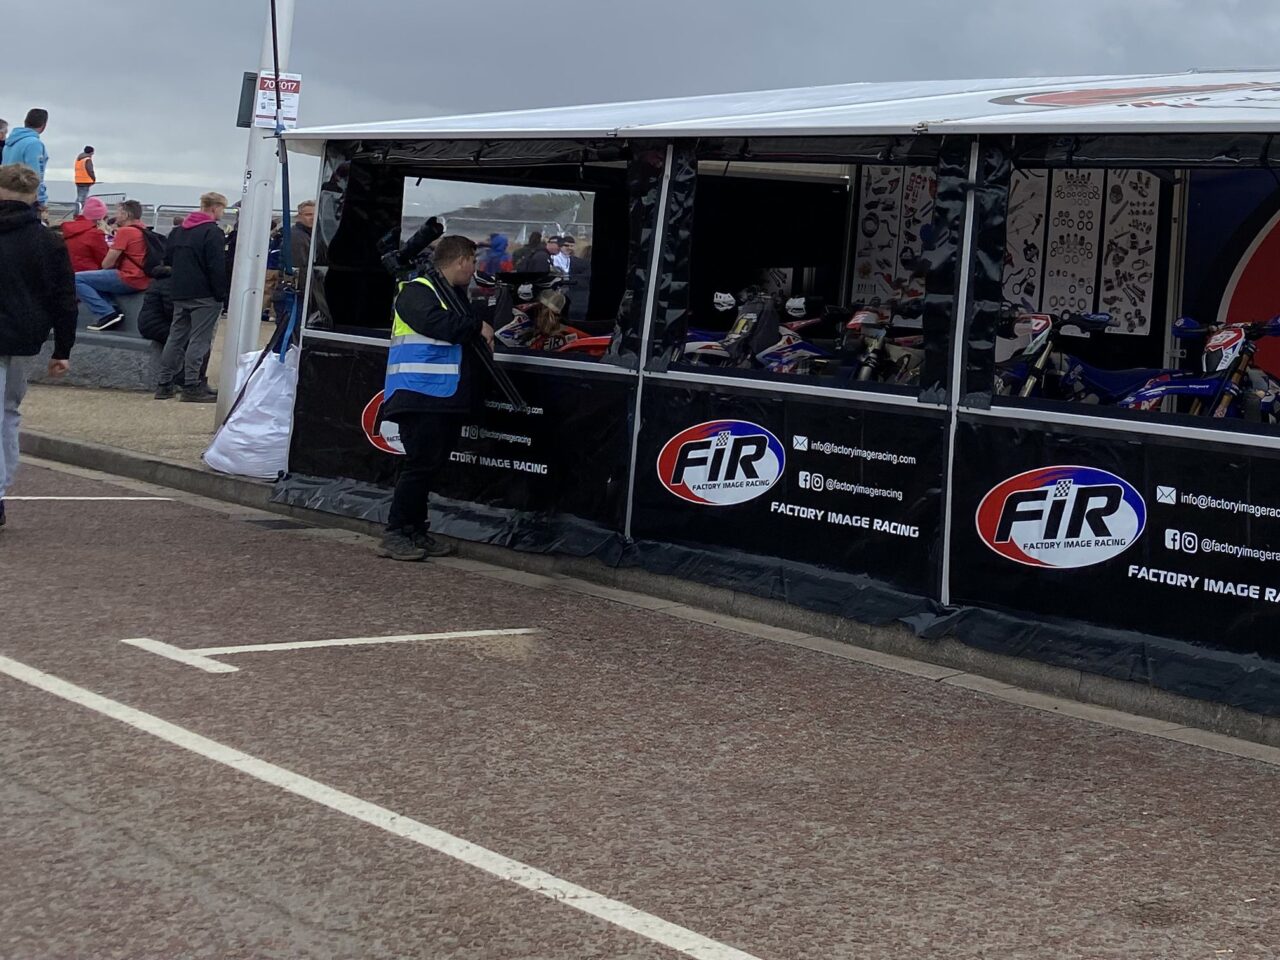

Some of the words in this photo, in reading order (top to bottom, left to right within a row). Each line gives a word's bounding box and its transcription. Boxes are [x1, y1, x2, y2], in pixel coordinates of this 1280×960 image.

[263, 80, 297, 91] 70017
[450, 451, 477, 464] CTORY
[480, 456, 511, 469] IMAGE
[513, 460, 548, 475] RACING
[811, 441, 916, 465] info@factoryimageracing.com
[825, 479, 903, 501] @factoryimageracing
[770, 501, 825, 521] FACTORY
[827, 511, 870, 528] IMAGE
[873, 518, 919, 538] RACING
[1023, 541, 1061, 550] FACTORY
[1064, 540, 1092, 548] IMAGE
[1094, 538, 1126, 547] RACING
[1128, 565, 1199, 589] FACTORY
[1203, 578, 1260, 599] IMAGE
